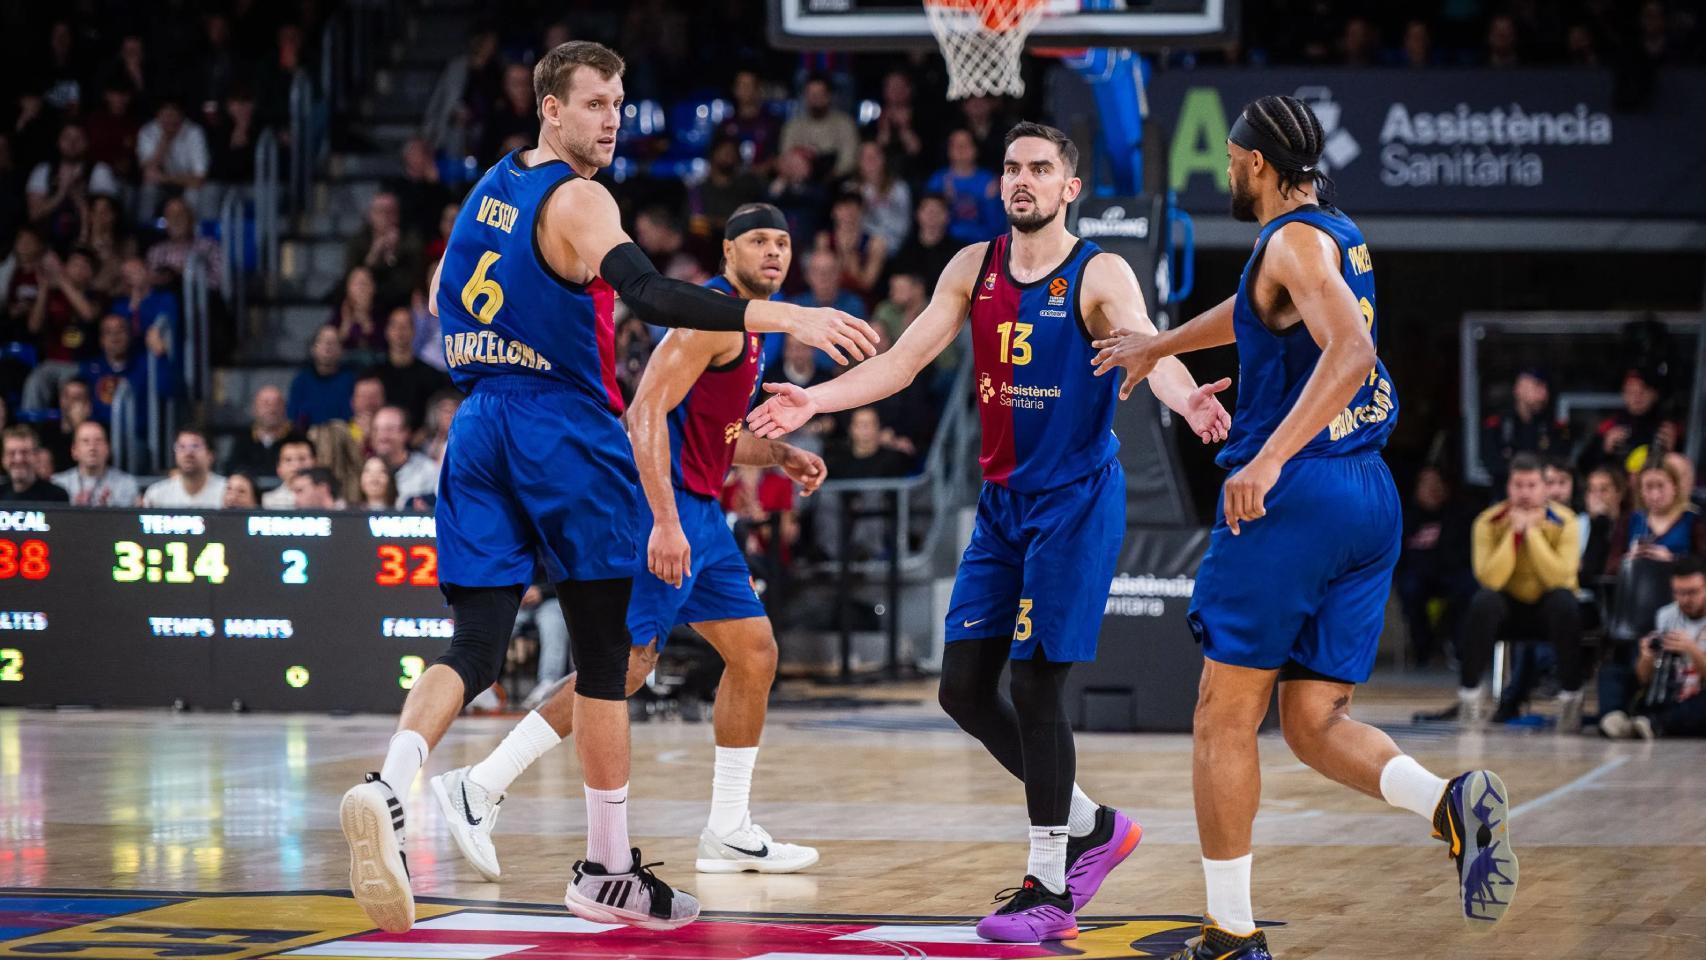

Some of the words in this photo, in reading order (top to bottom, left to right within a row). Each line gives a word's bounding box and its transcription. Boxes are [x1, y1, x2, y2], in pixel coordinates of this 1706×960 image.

[1168, 86, 1231, 193] A
[1380, 103, 1613, 144] Assistència
[1380, 143, 1543, 186] Sanitària
[461, 250, 503, 325] 6
[445, 330, 552, 370] BARCELONA
[997, 321, 1034, 366] 13
[1000, 394, 1044, 409] Sanitària
[139, 515, 206, 535] TEMPS
[248, 516, 332, 537] PERIODE
[368, 515, 437, 537] VISITA
[112, 541, 229, 584] 3:14
[281, 549, 309, 584] 2
[375, 544, 439, 587] 32
[149, 616, 215, 637] TEMPS
[224, 619, 293, 638] MORTS
[382, 617, 454, 638] FALTES
[1013, 598, 1033, 641] 3
[0, 648, 25, 682] 2
[399, 655, 426, 690] 3
